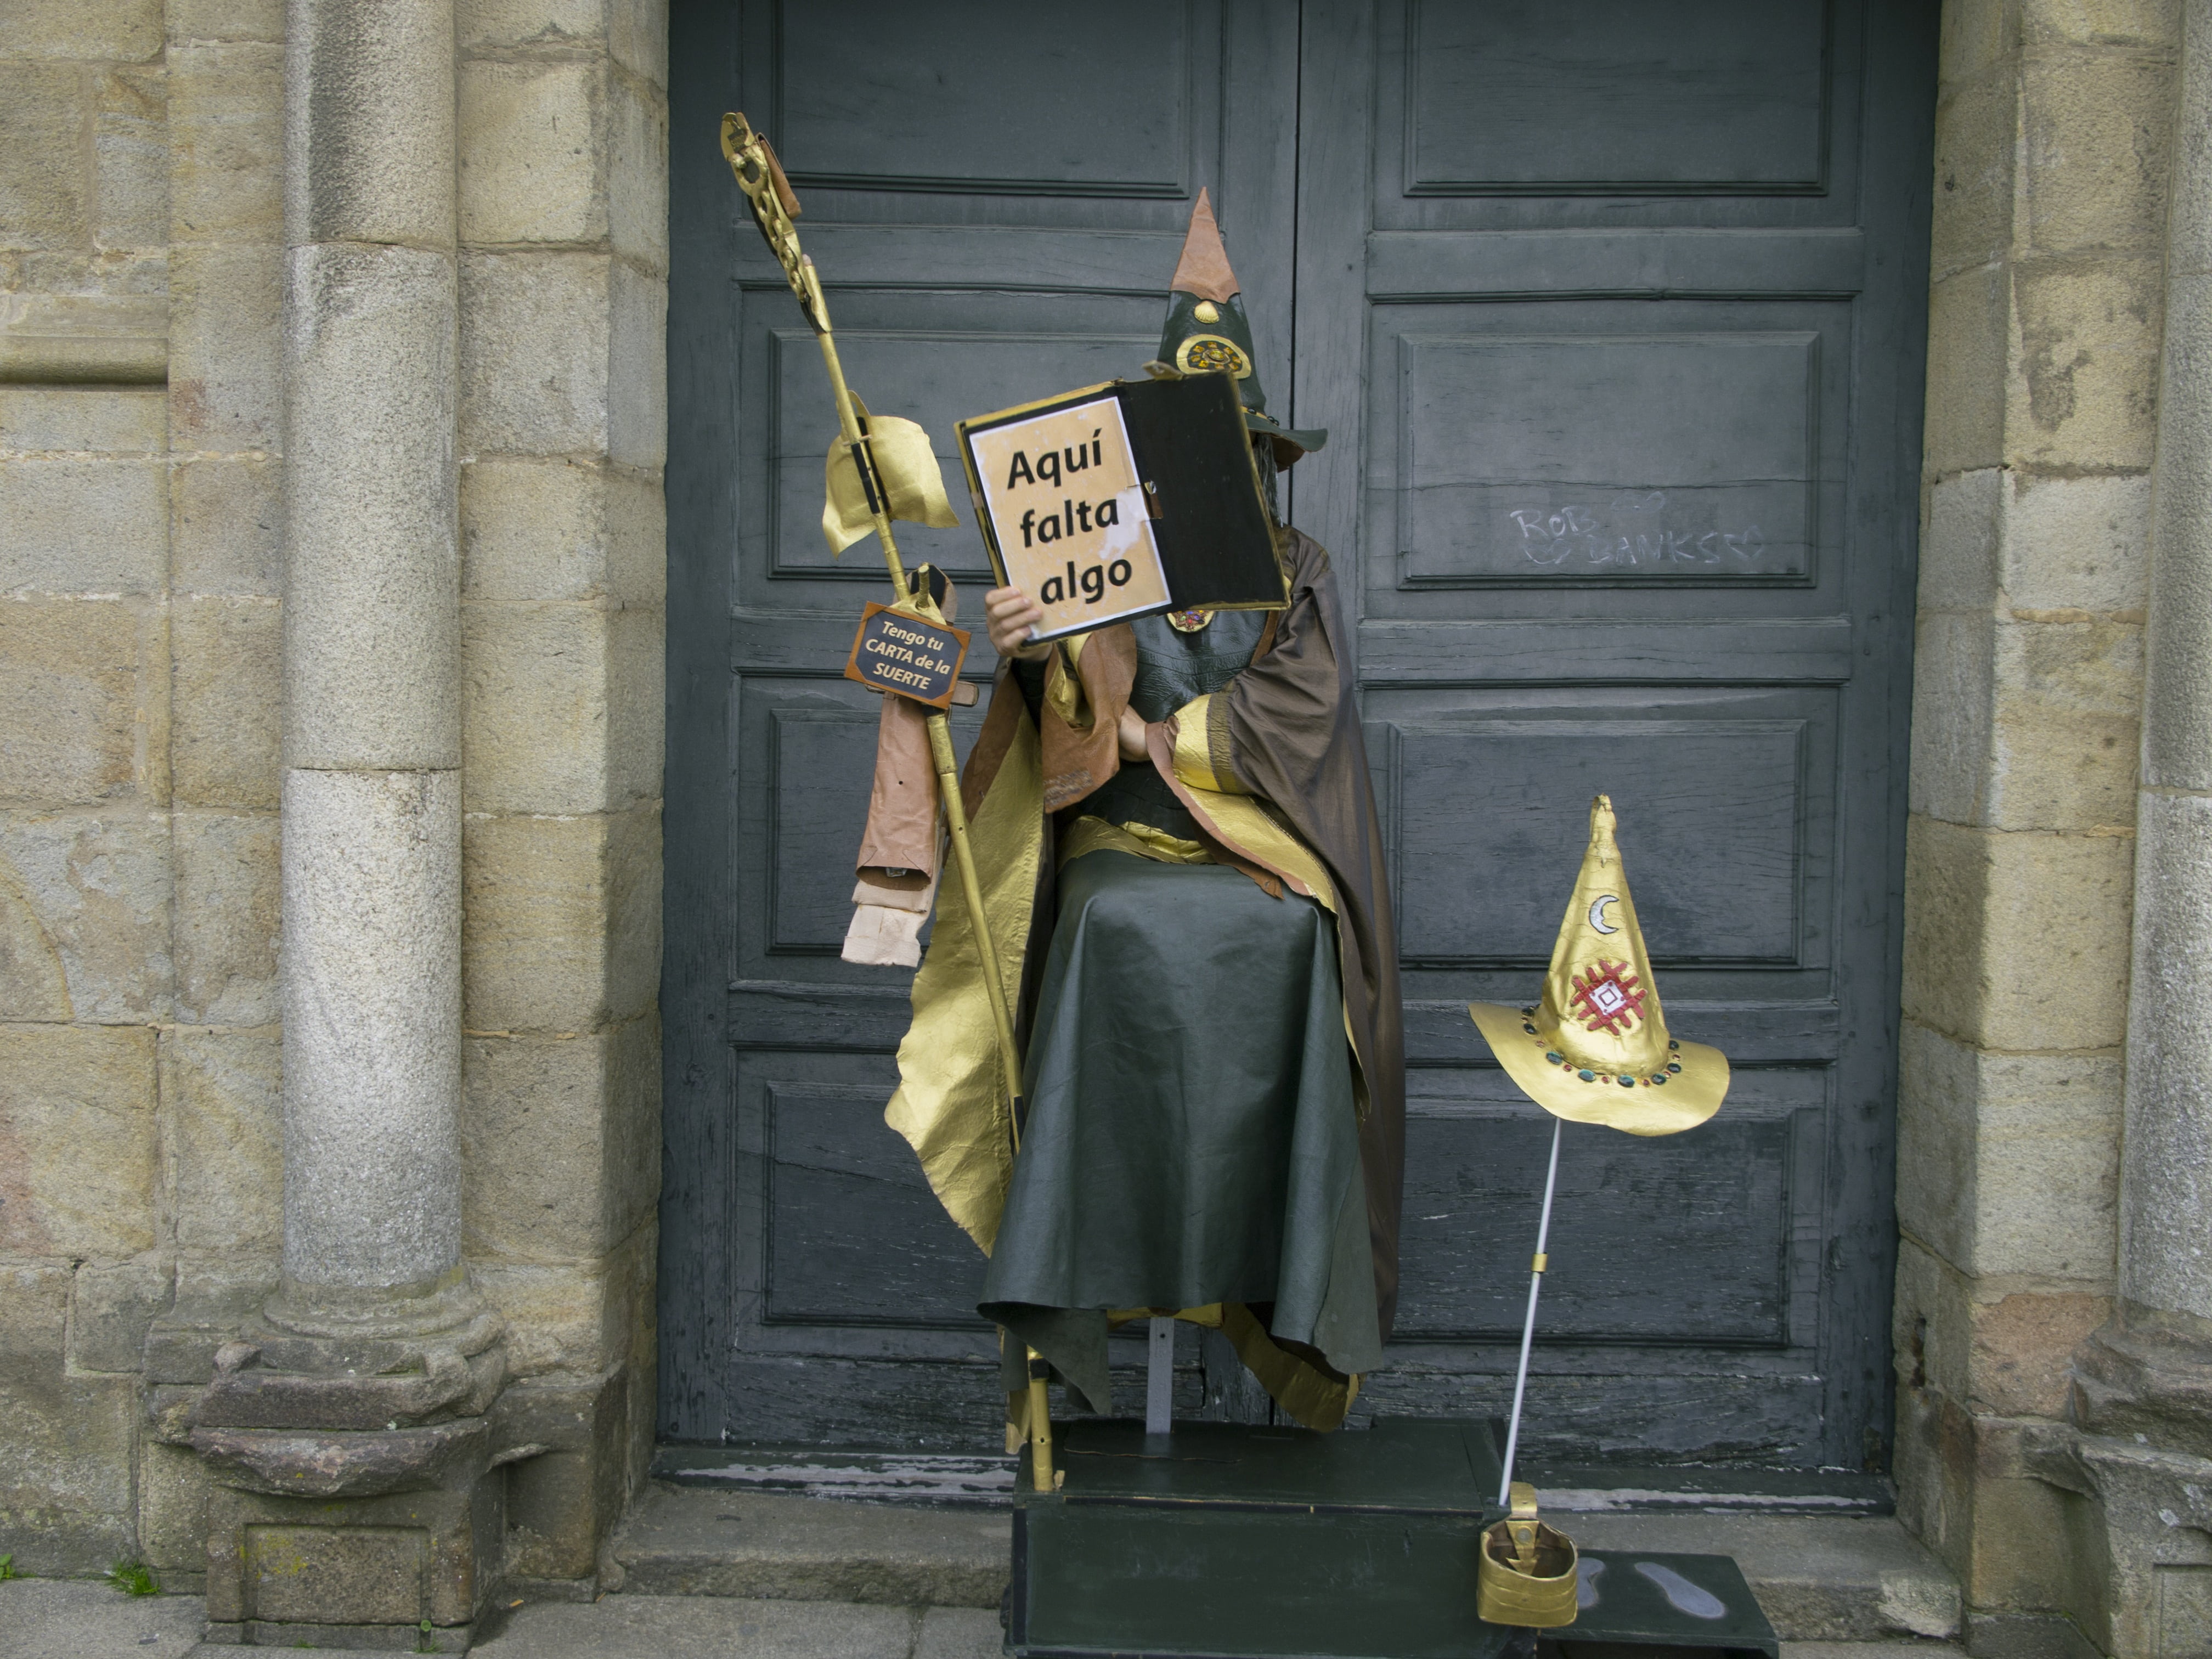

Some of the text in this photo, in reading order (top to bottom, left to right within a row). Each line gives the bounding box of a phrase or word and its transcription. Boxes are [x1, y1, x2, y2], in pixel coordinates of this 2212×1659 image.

[1007, 428, 1102, 489] Aquí
[1020, 499, 1119, 548] falta
[1041, 559, 1132, 604] algo
[882, 621, 944, 651] Tengo tu
[865, 639, 951, 675] CARTA de la
[873, 663, 932, 690] SUERTE
